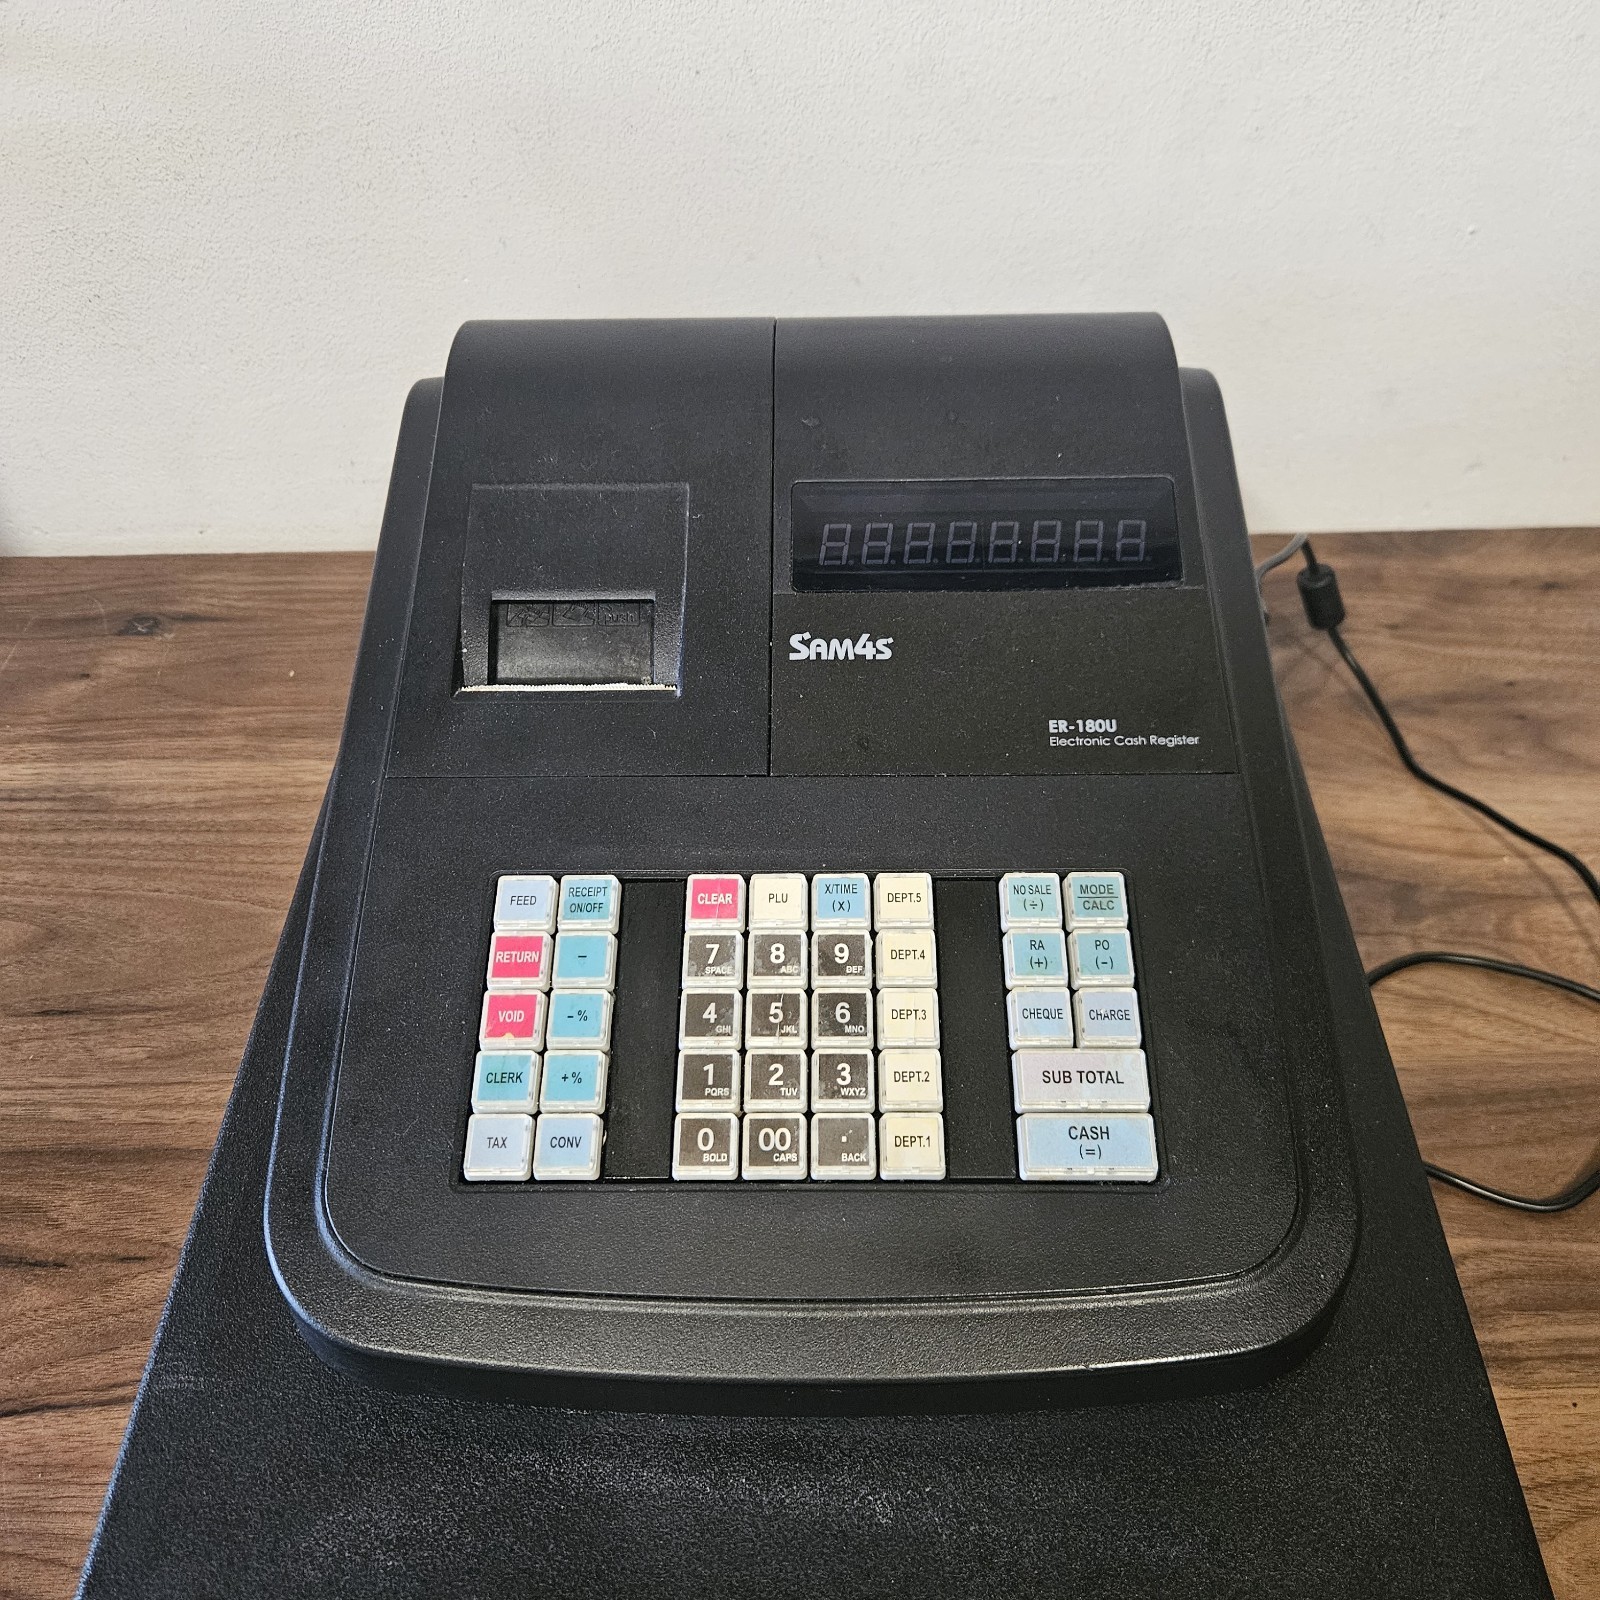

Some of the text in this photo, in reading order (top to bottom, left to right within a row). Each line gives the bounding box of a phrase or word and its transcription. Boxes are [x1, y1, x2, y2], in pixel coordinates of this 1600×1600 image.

[1048, 718, 1117, 733] ER-180U
[1049, 734, 1199, 747] Electronic Cash Register
[568, 887, 607, 897] RECEIPT
[824, 884, 858, 894] X/TIME
[1028, 885, 1052, 895] SALE
[1080, 884, 1114, 895] MODE
[510, 895, 537, 906] FEED
[697, 894, 732, 904] CLEAR
[768, 894, 788, 903] PLU
[887, 893, 922, 903] DEPT.5
[570, 902, 604, 913] ON/OFF
[1082, 900, 1115, 911] CALC
[1030, 940, 1045, 950] RA
[1095, 940, 1110, 950] PO
[495, 952, 539, 963] RETURN
[705, 943, 720, 964] 7
[770, 943, 785, 964] 8
[834, 943, 849, 964] 9
[890, 949, 926, 960] DEPT.4
[705, 966, 733, 974] SPACE
[498, 1011, 525, 1022] VOID
[702, 1003, 717, 1023] 4
[769, 1002, 783, 1023] 5
[835, 1002, 850, 1023] 6
[891, 1009, 927, 1020] DEPT.3
[1022, 1008, 1063, 1019] CHEQUE
[1089, 1009, 1131, 1021] CHARGE
[716, 1025, 731, 1033] GHI
[781, 1025, 797, 1033] JKL
[845, 1025, 864, 1033] MNO
[486, 1072, 523, 1084] CLERK
[703, 1064, 714, 1085] 1
[768, 1063, 784, 1085] 2
[836, 1063, 851, 1085] 3
[894, 1071, 930, 1082] DEPT.2
[1042, 1071, 1124, 1084] SUB TOTAL
[705, 1087, 730, 1096] PQRS
[780, 1087, 798, 1096] TUV
[840, 1087, 866, 1096] WXYZ
[697, 1127, 714, 1150] 0
[758, 1127, 791, 1150] 00
[1068, 1126, 1110, 1140] CASH
[487, 1137, 507, 1148] TAX
[550, 1136, 582, 1148] CONV
[894, 1136, 931, 1147] DEPT.1
[703, 1153, 728, 1162] BOLD
[773, 1153, 797, 1162] CAPS
[841, 1153, 866, 1162] BACK
